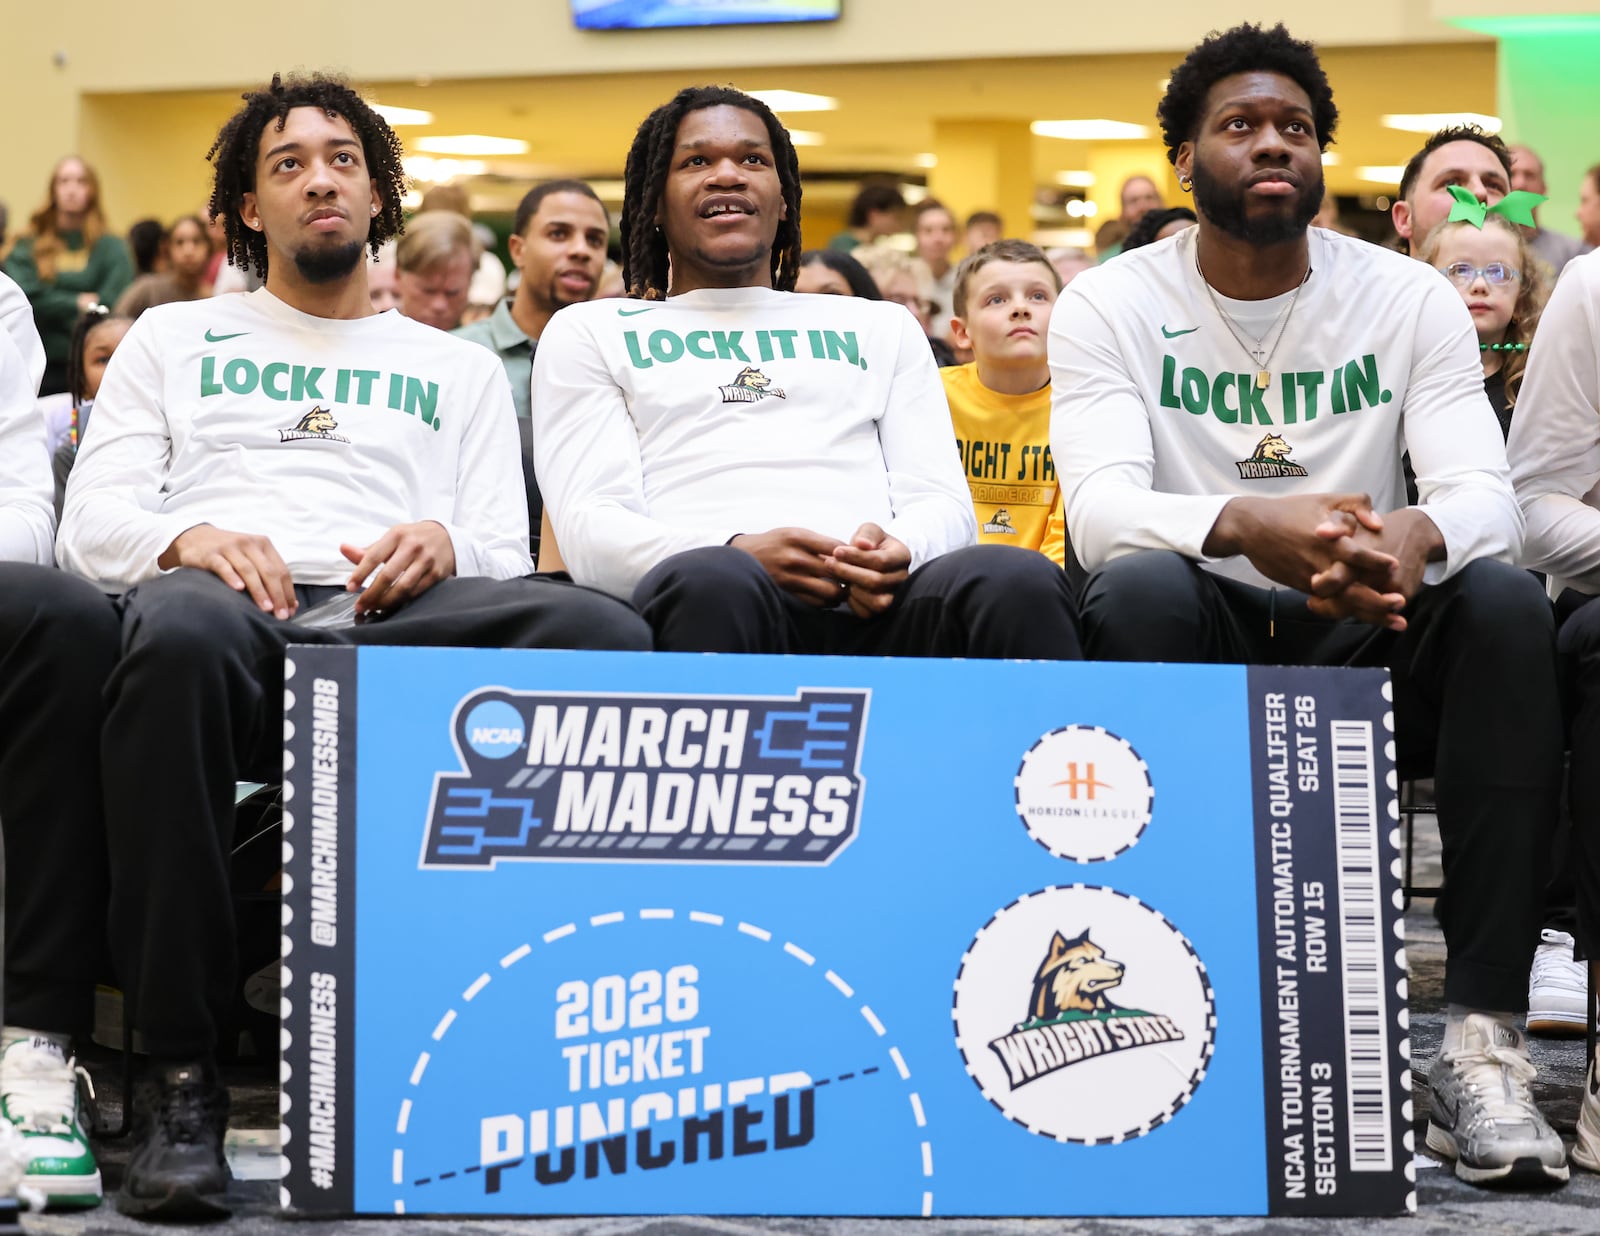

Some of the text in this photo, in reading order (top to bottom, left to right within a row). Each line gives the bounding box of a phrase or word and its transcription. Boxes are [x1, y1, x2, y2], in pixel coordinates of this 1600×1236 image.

[623, 329, 868, 371] LOCK IT IN.
[200, 356, 441, 432] LOCK IT IN.
[721, 386, 760, 402] WRIGHT
[1160, 353, 1393, 426] LOCK IT IN.
[1238, 462, 1308, 478] WRIGHT STATE
[471, 726, 524, 745] NCAA
[526, 704, 750, 769] MARCH
[552, 770, 853, 836] MADNESS
[1028, 806, 1081, 817] HORIZON
[309, 677, 339, 1191] #MARCHMADNESS @MARCHMADNESSMBB
[1265, 692, 1306, 1199] NCAA TOURNAMENT AUTOMATIC QUALIFIER
[1294, 695, 1337, 1196] SECTION 3 ROW 15 SEAT 26
[555, 964, 700, 1039] 2026
[562, 1026, 711, 1092] TICKET
[992, 1015, 1184, 1086] WRIGHT STATE
[480, 1070, 815, 1194] PUNCHED
